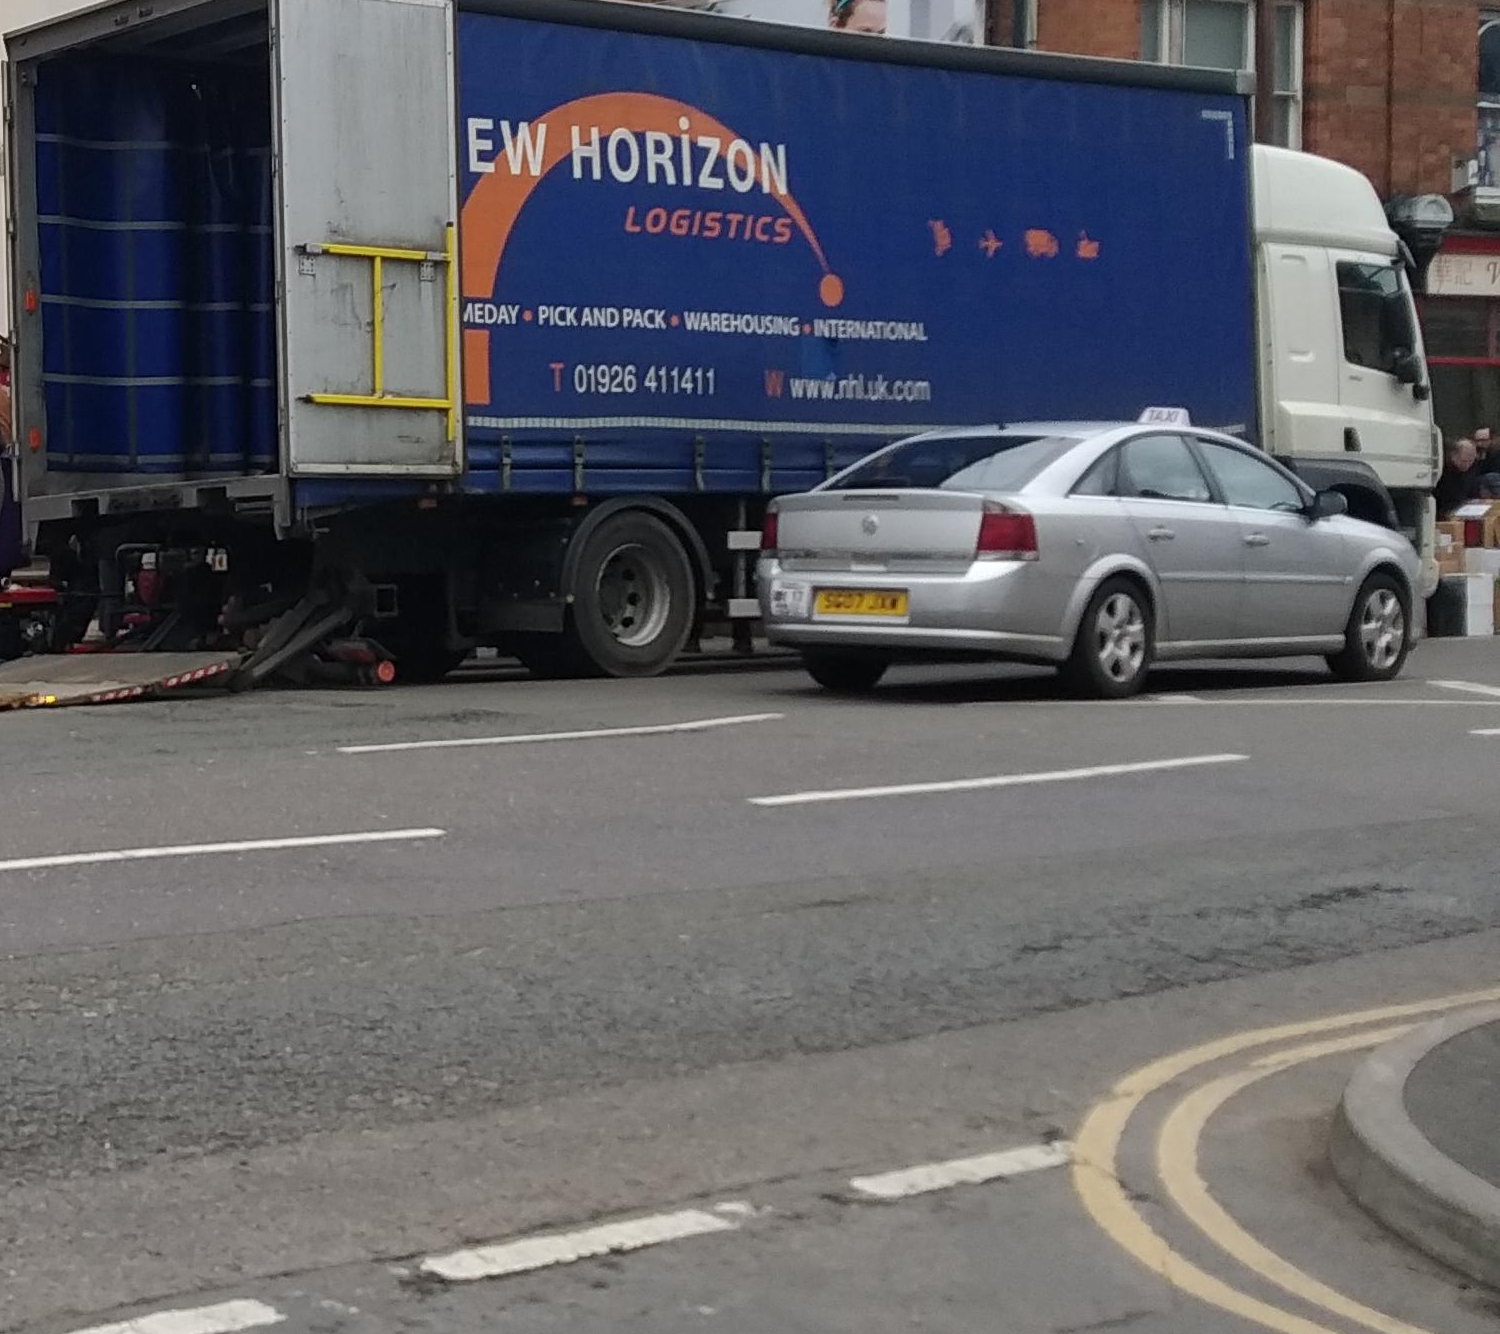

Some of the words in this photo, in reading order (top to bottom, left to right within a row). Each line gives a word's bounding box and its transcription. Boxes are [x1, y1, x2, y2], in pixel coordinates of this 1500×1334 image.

[623, 206, 793, 244] LOGISTICS
[538, 305, 579, 327] PICK
[580, 306, 620, 328] AND
[622, 308, 668, 330] PACK
[683, 311, 800, 337] WAREHOUSING
[813, 318, 929, 341] INTERNATIONAL
[549, 362, 565, 393] T
[574, 364, 638, 394] 01926
[644, 365, 715, 396] 411411
[764, 369, 785, 399] W
[1149, 409, 1181, 423] TAXI
